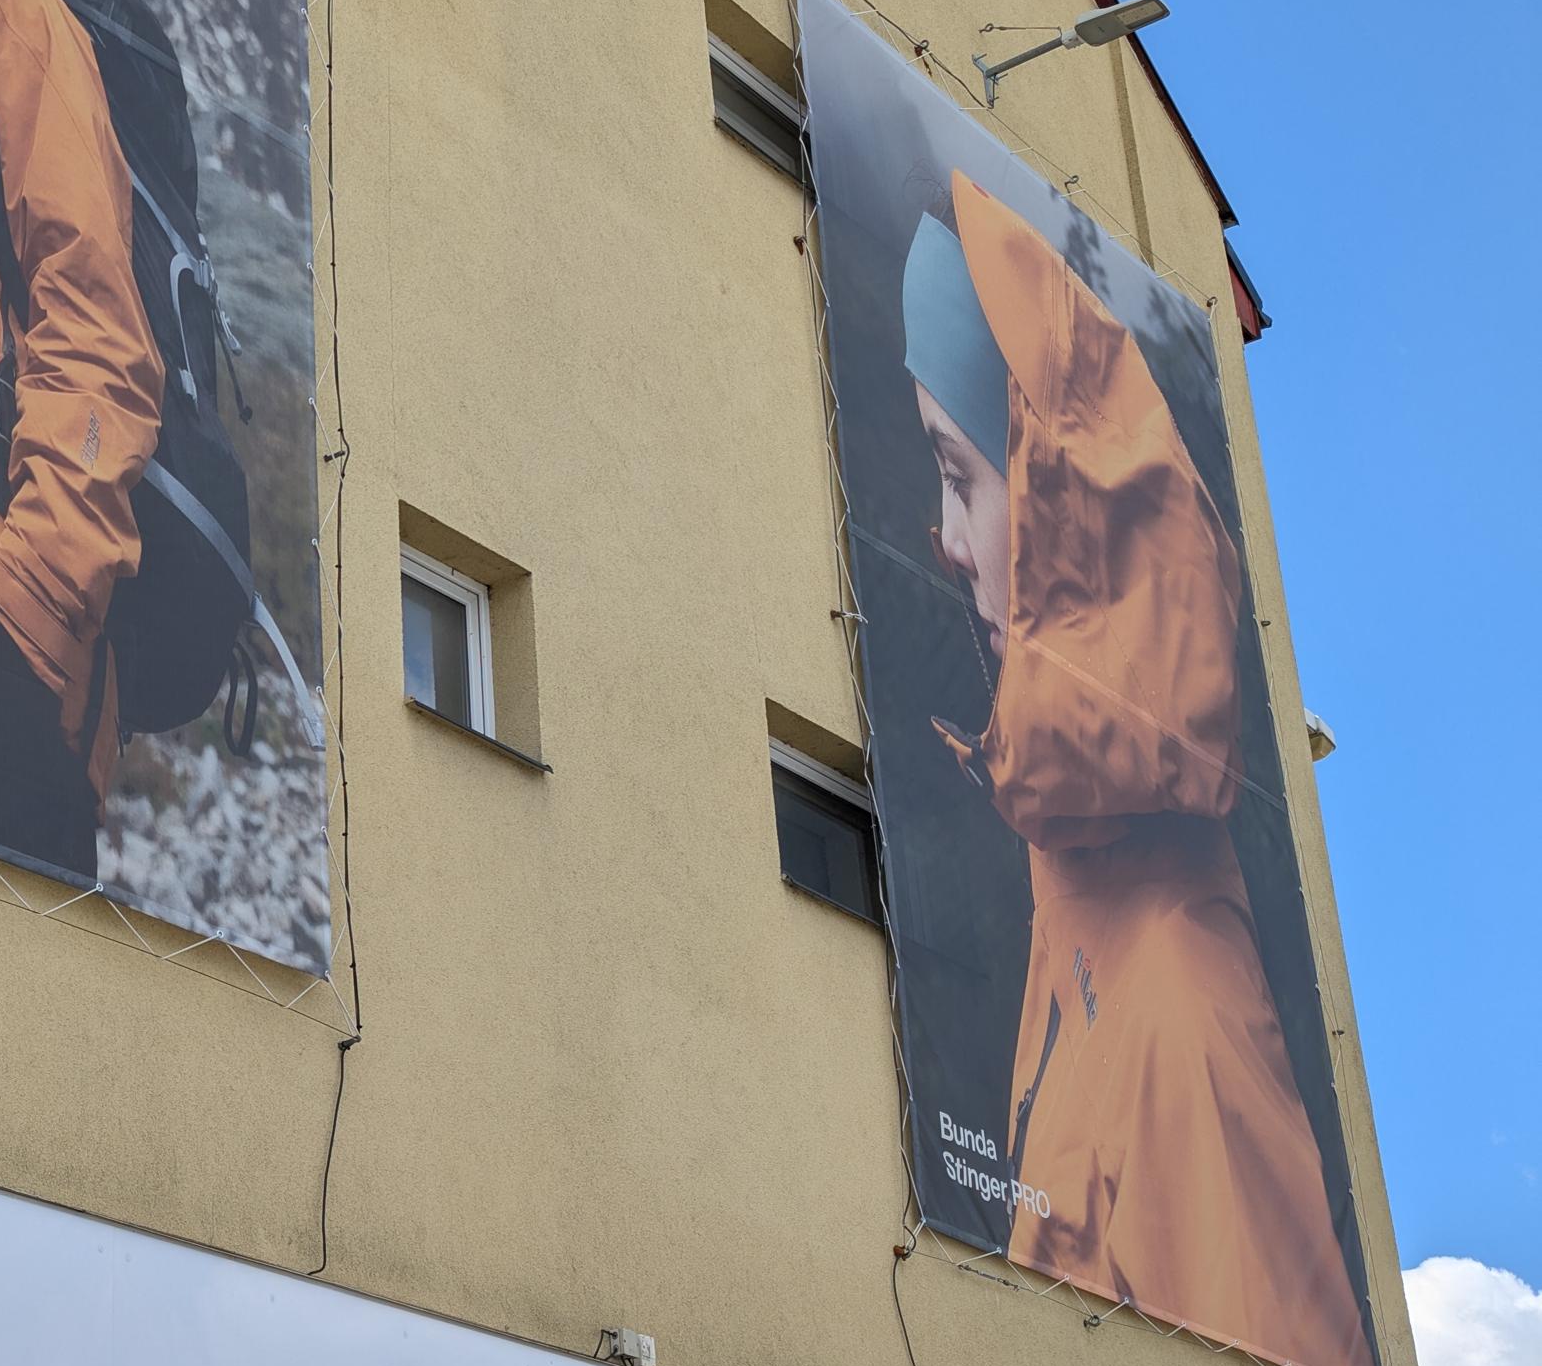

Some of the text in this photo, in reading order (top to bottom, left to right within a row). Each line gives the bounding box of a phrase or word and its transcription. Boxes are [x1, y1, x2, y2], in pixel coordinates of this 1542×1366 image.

[939, 1111, 998, 1161] Bunda
[942, 1151, 1050, 1218] Stinger PRO
